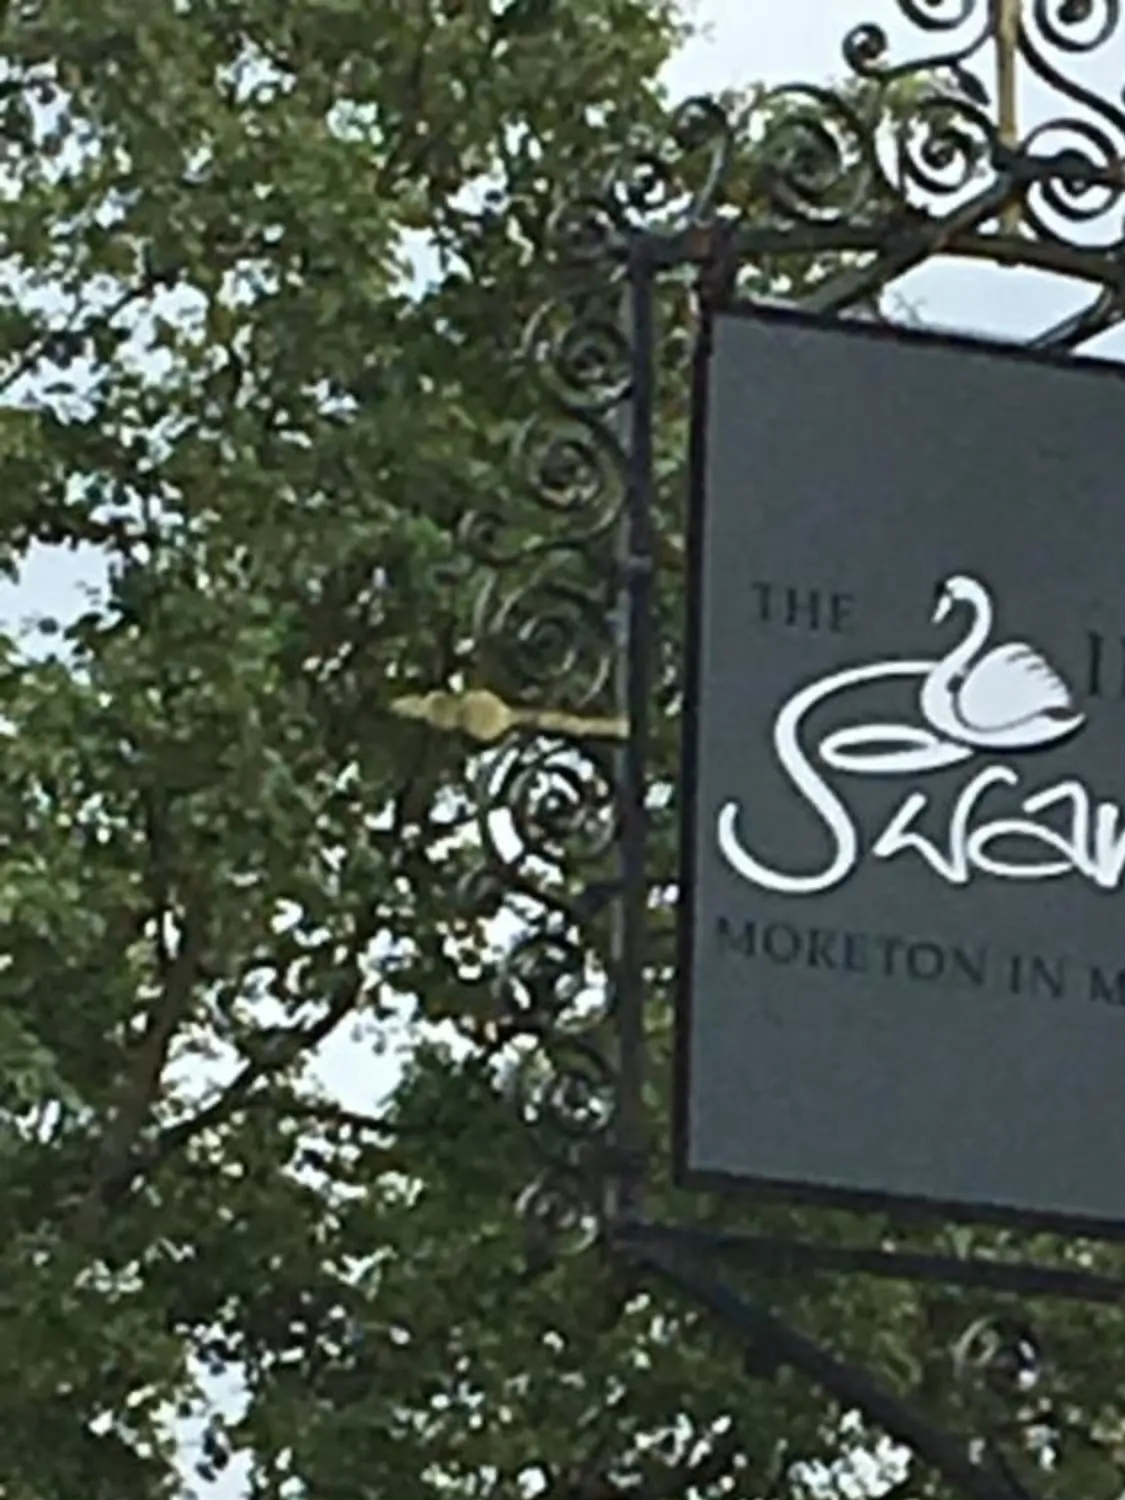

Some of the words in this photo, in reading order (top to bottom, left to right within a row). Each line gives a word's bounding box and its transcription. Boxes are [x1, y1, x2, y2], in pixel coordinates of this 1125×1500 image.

[752, 582, 856, 634] THE
[715, 916, 987, 987] MORETON
[1008, 955, 1064, 999] IN
